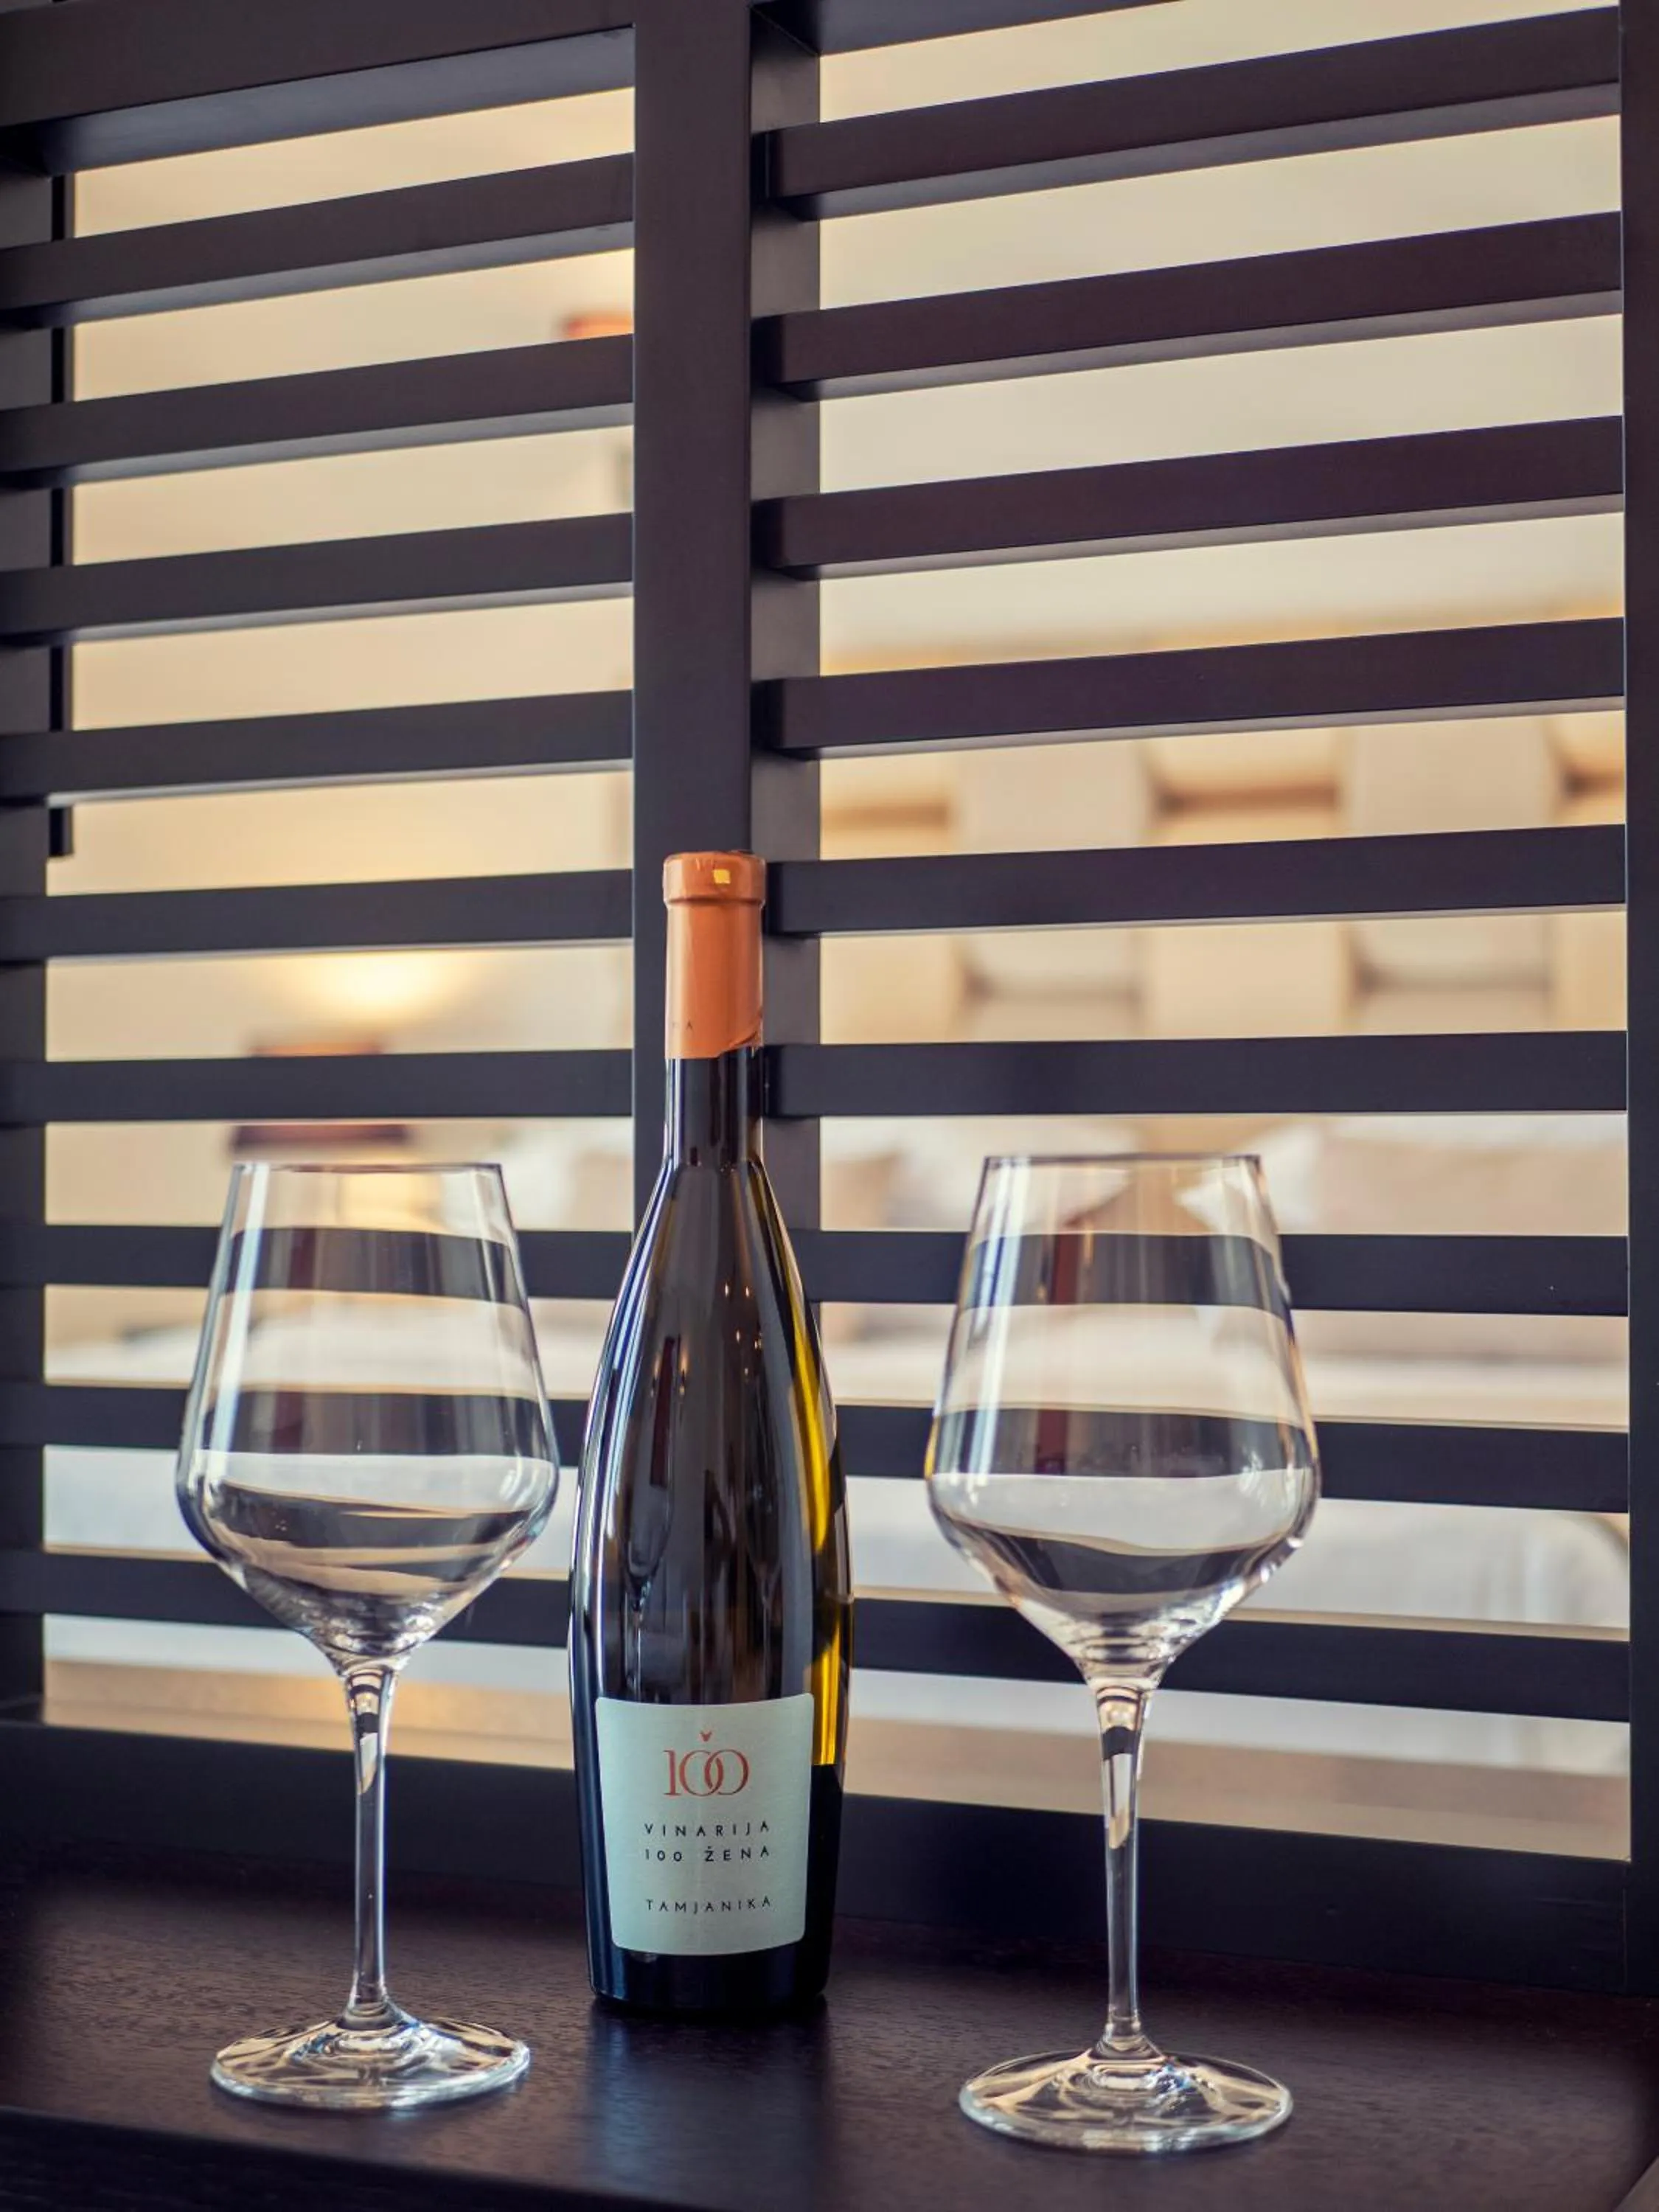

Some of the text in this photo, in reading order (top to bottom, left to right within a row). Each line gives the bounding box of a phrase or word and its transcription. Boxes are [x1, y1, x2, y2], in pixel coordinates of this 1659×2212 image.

[662, 1748, 749, 1797] 100
[644, 1820, 770, 1837] VINARIJA
[644, 1845, 770, 1863] 100 ŽENA
[645, 1895, 771, 1915] TAMJANIKA
